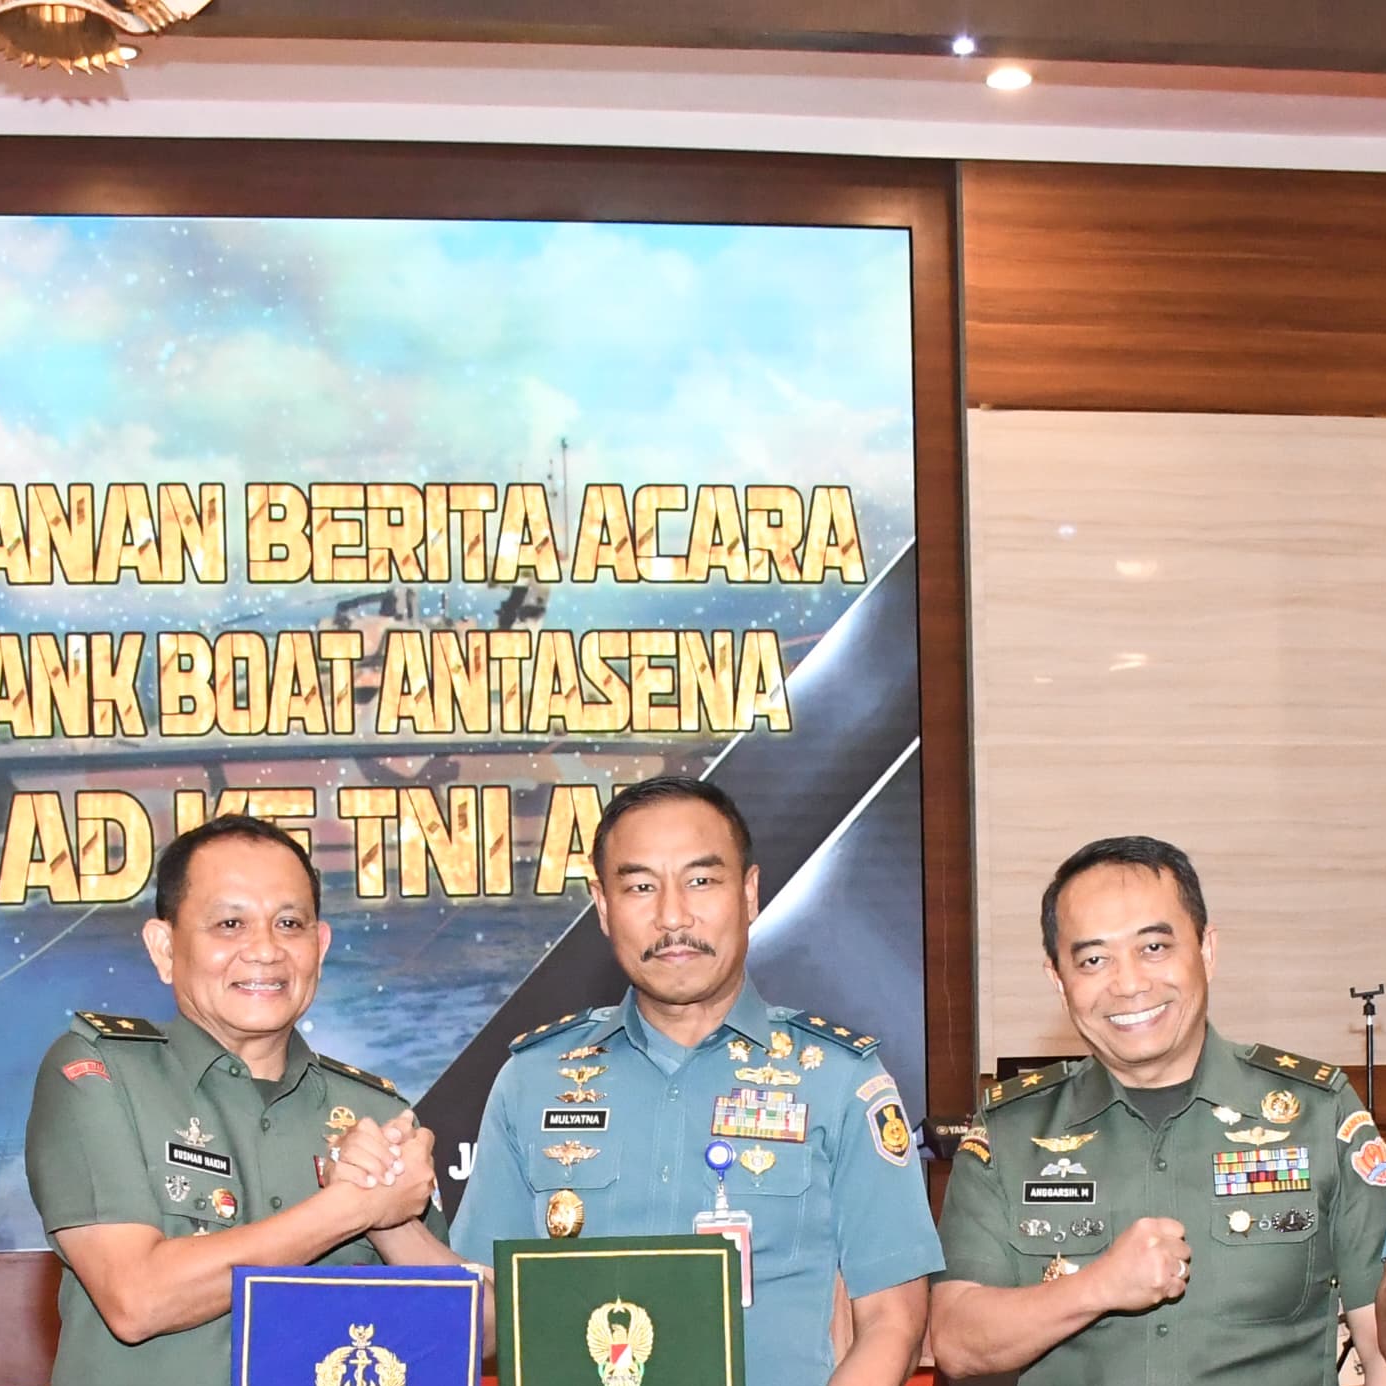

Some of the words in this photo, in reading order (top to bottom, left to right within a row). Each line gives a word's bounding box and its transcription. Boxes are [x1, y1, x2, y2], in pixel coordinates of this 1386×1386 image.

[246, 482, 562, 586] BERITA
[571, 484, 866, 584] ACARA
[159, 631, 363, 738] BOAT
[375, 630, 792, 735] ANTASENA
[338, 785, 514, 898] TNI
[534, 784, 631, 896] A
[549, 1113, 600, 1125] MULYATNA
[948, 1125, 969, 1135] YAM
